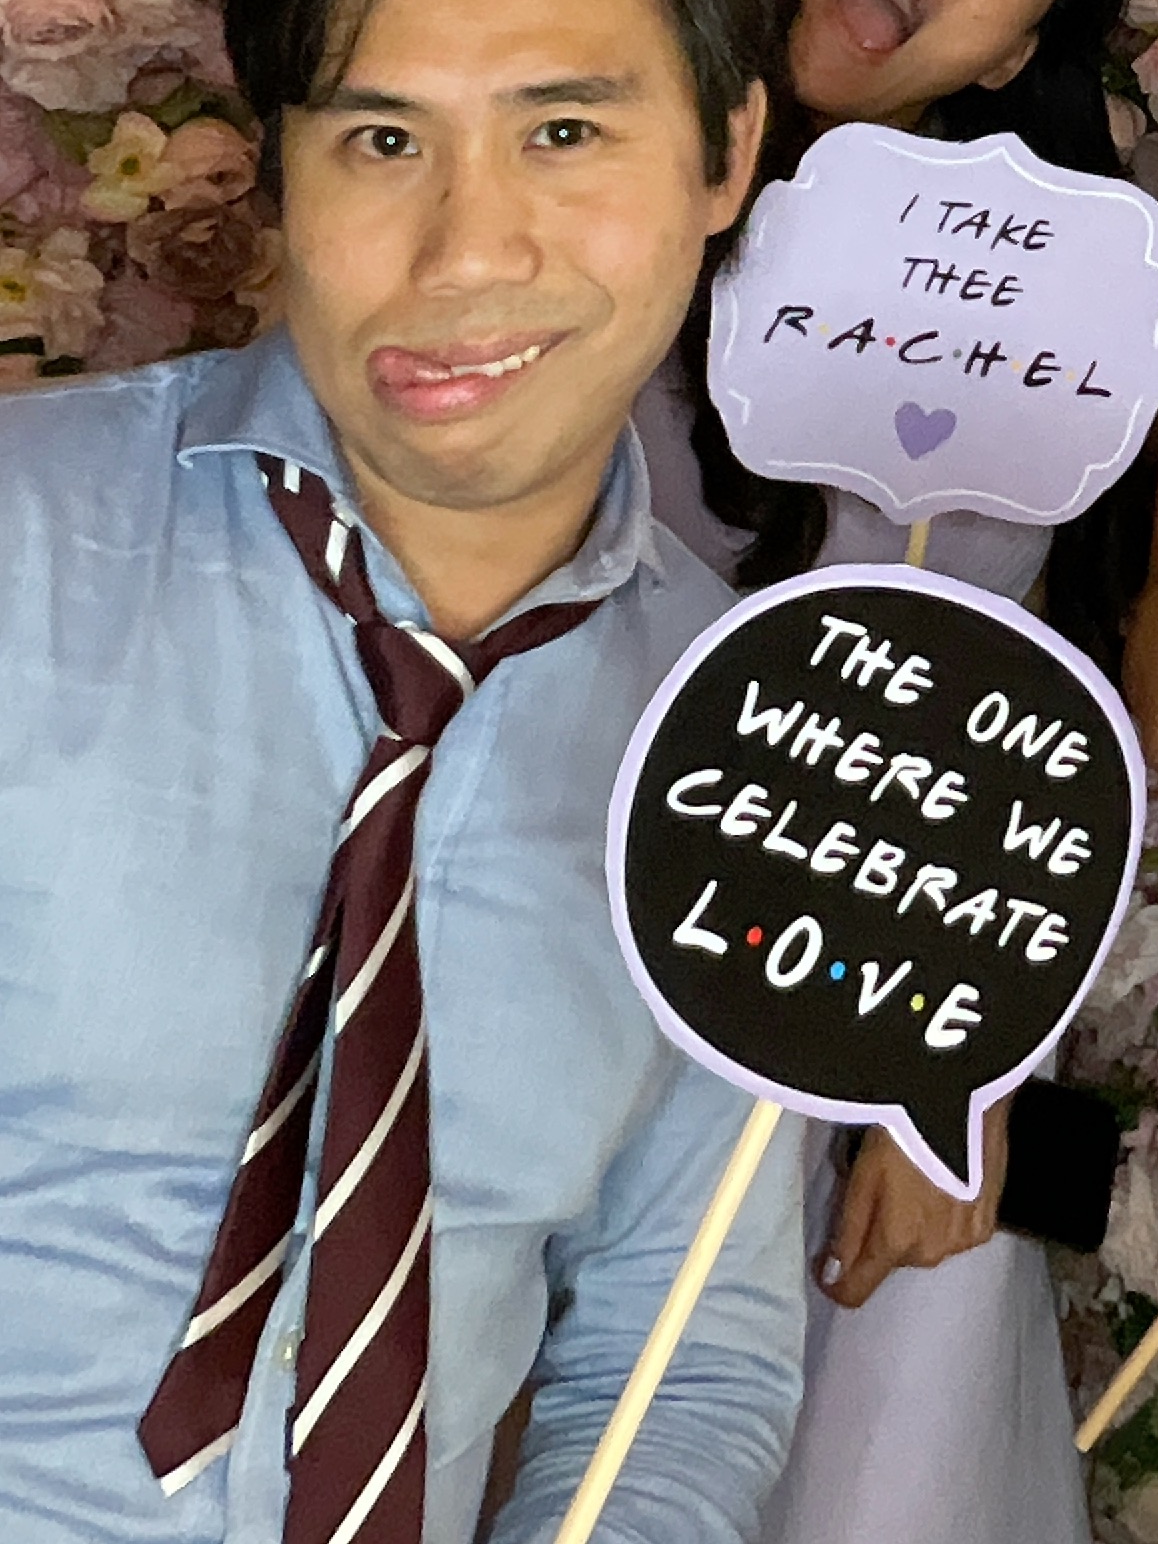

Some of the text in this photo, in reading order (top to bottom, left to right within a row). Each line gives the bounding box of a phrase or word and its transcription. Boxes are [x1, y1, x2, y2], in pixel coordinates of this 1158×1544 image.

[899, 193, 1055, 251] I TAKE
[901, 256, 1024, 306] THEE
[736, 679, 1094, 876] WHERE WE
[810, 614, 1091, 779] THE ONE
[665, 768, 1071, 963] CELEBRATE
